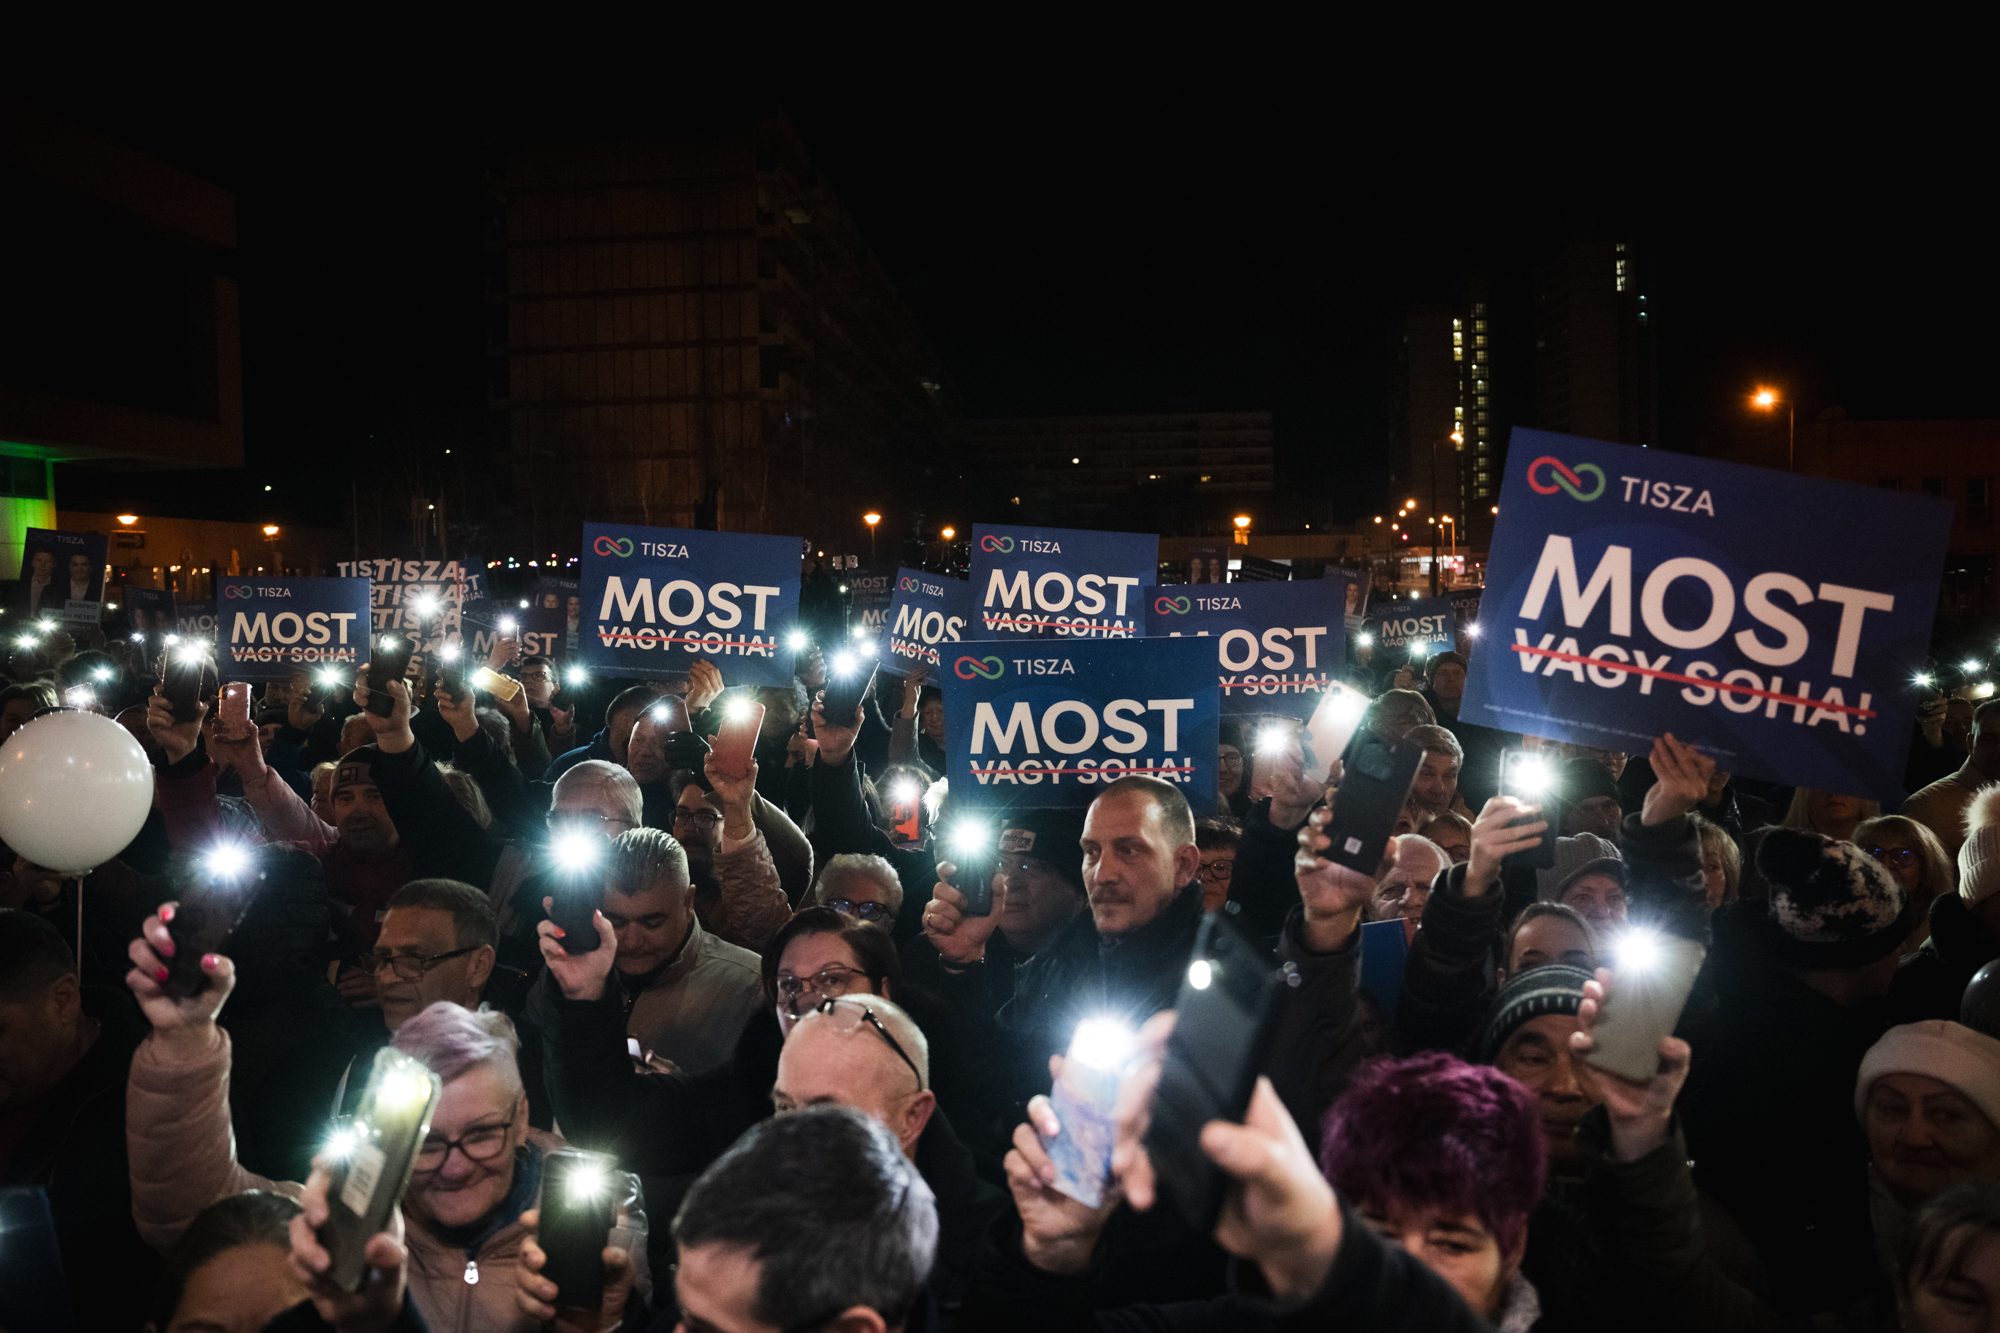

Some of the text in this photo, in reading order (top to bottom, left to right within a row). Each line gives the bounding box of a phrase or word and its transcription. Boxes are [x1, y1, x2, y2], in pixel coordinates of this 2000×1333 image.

[1619, 474, 1717, 518] TISZA
[56, 535, 85, 546] TISZA
[640, 541, 690, 559] TISZA
[1019, 539, 1062, 554] TISZA
[374, 560, 459, 582] TISZA
[850, 576, 889, 589] MOST
[142, 591, 159, 600] TISZA
[256, 587, 292, 598] TISZA
[559, 580, 578, 589] TISZA
[921, 583, 944, 597] TISZA
[983, 568, 1140, 616] MOST
[598, 575, 781, 631] MOST
[1196, 597, 1242, 611] TISZA
[1392, 605, 1411, 613] TISZA
[1451, 597, 1479, 609] MOS
[1518, 533, 1895, 679] MOST
[231, 611, 357, 645] MOST
[892, 603, 967, 645] MOS
[982, 611, 1136, 639] VAGY SOHA!
[1382, 614, 1446, 638] MOST
[471, 630, 558, 656] MST
[597, 625, 678, 651] VAGY
[683, 630, 776, 658] SOHA!
[890, 636, 927, 661] VAGY
[1169, 626, 1328, 672] OST
[1382, 637, 1410, 648] VAGY
[231, 646, 356, 663] VAGY SOHA!
[1012, 658, 1076, 676] TISZA
[1243, 672, 1327, 696] SOHA!
[1513, 628, 1672, 696] VAGY
[1680, 660, 1873, 737] SOHA!
[969, 698, 1195, 755] MOST
[969, 757, 1192, 785] VAGY SOHA!
